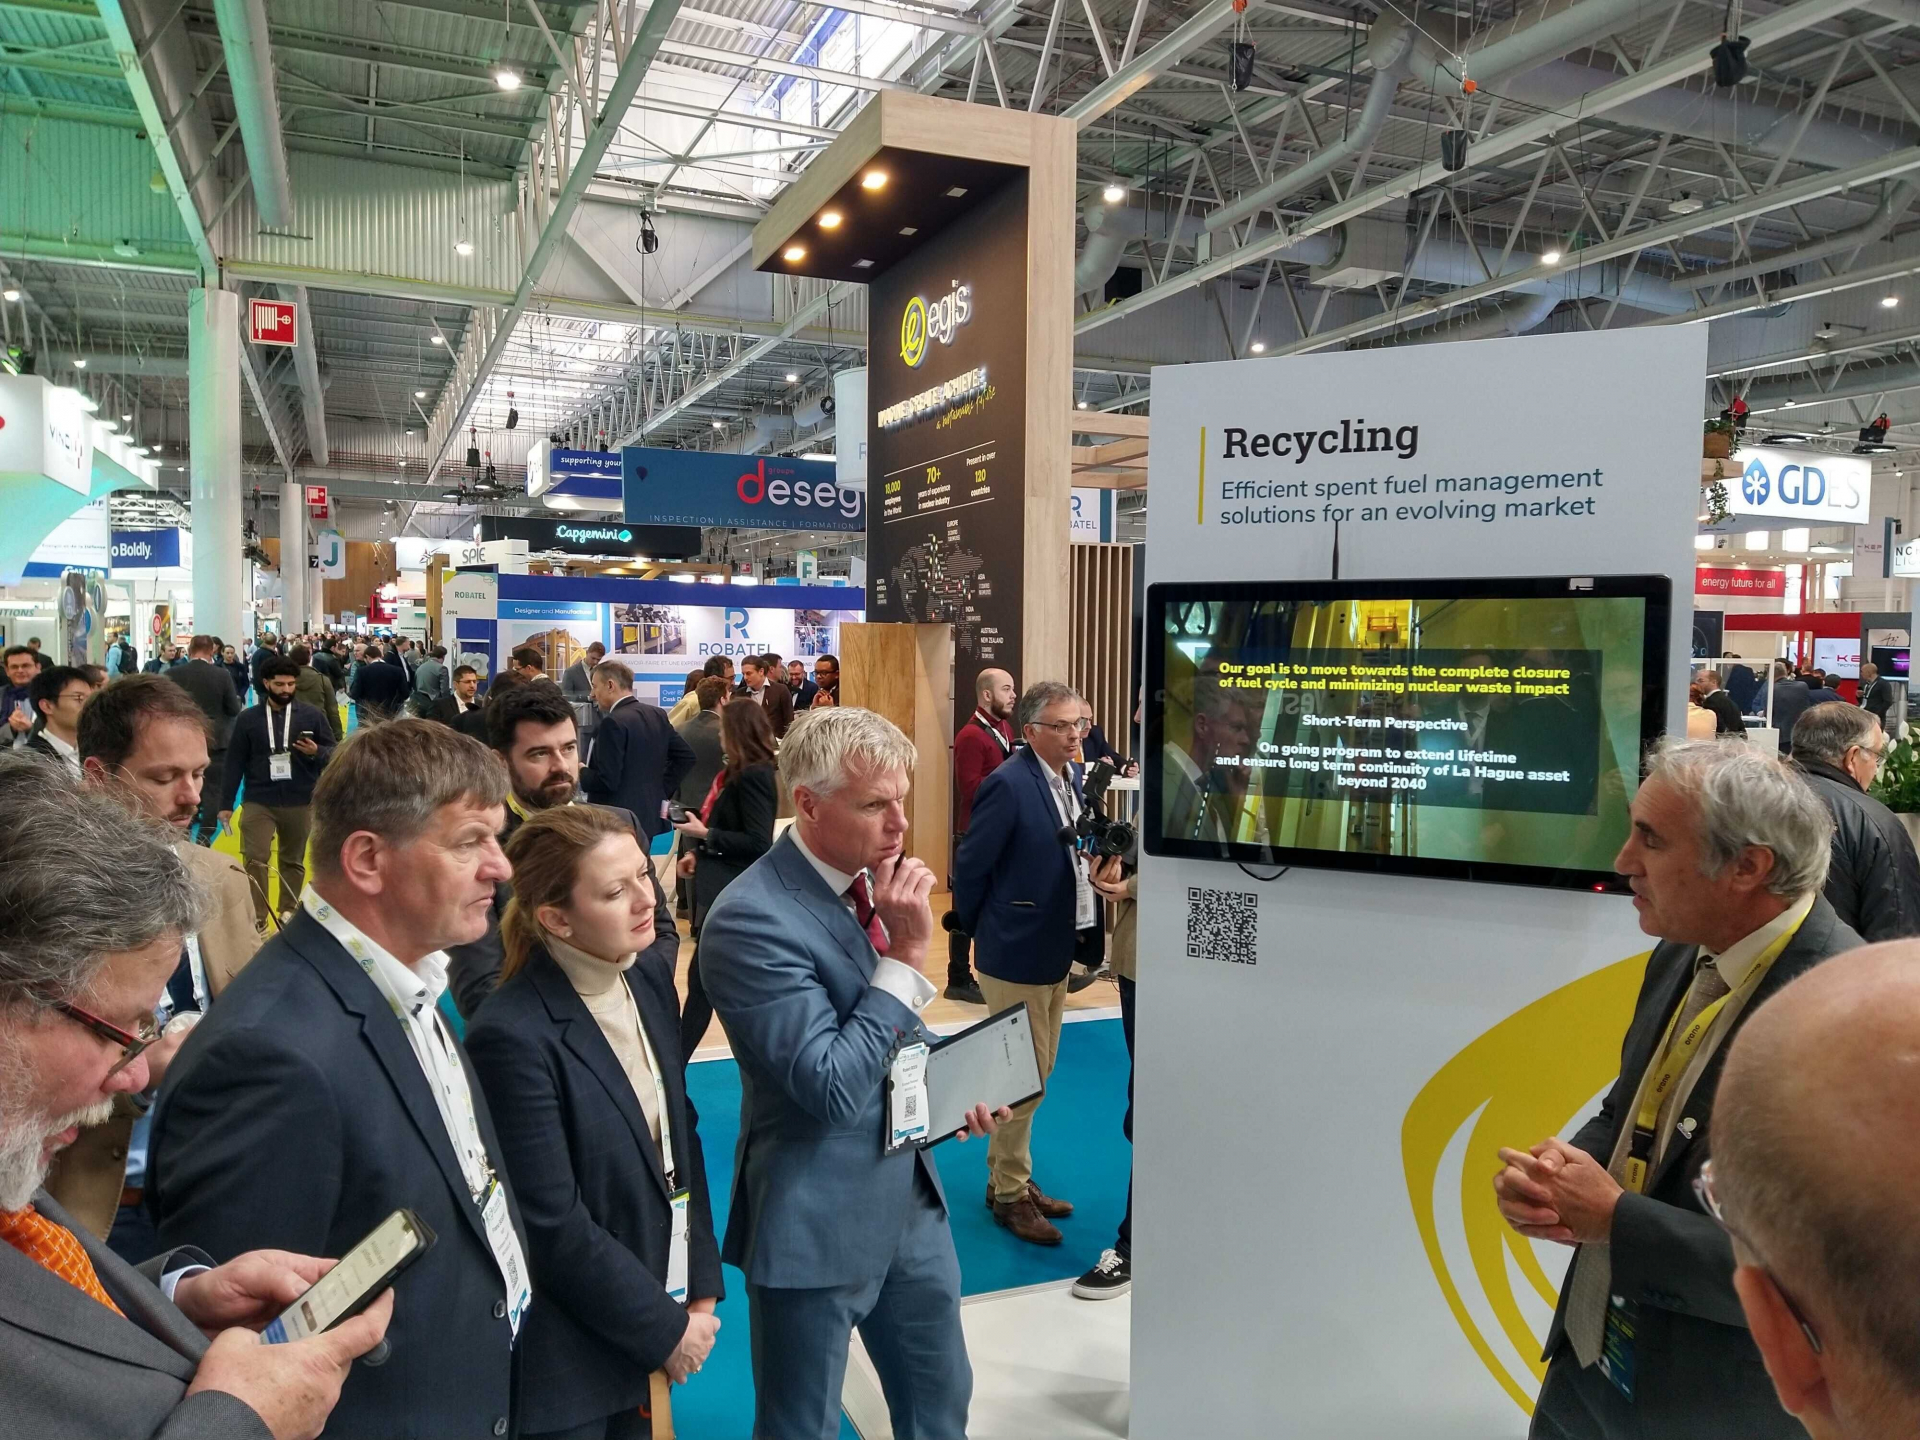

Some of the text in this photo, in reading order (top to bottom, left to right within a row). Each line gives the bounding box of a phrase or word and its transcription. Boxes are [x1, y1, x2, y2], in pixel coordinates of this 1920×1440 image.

[927, 279, 970, 344] egis
[1222, 418, 1419, 464] Recycling
[560, 456, 622, 469] supporting your
[966, 454, 981, 466] Present
[986, 451, 996, 461] over
[768, 467, 794, 475] groupe
[926, 466, 941, 484] 70+
[975, 468, 986, 483] 120
[736, 458, 868, 518] deseg
[918, 490, 927, 500] years
[931, 484, 951, 496] experience
[971, 485, 990, 497] countries
[1222, 468, 1604, 500] Efficient spent fuel management
[1778, 464, 1860, 509] GDES
[922, 500, 935, 509] nuclear
[935, 496, 950, 507] industry
[1220, 496, 1596, 525] solutions for an evolving market
[650, 515, 854, 530] INSPECTION ASSISTANCE FORMATION
[558, 525, 618, 544] Capgemini
[120, 541, 152, 559] Boldly.
[322, 541, 338, 567] J
[462, 547, 486, 564] SPIE
[802, 561, 812, 578] F
[1702, 577, 1776, 589] energy future for all
[454, 591, 486, 600] ROBATEL
[0, 609, 34, 617] TIONS
[514, 607, 540, 615] Designer
[1218, 662, 1571, 679] Our goal is to move towards the complete closure
[1218, 677, 1570, 696] of fuel cycle and minimizing nuclear waste impact
[1302, 714, 1468, 731] Short-Term Perspective
[1259, 741, 1517, 763] On going program to extend lifetime
[1215, 755, 1571, 782] and ensure long term continuity of La Hague asset
[1337, 774, 1427, 790] beyond 2040
[1685, 1024, 1701, 1046] orano
[1656, 1073, 1671, 1093] orano
[1631, 1162, 1640, 1184] orano
